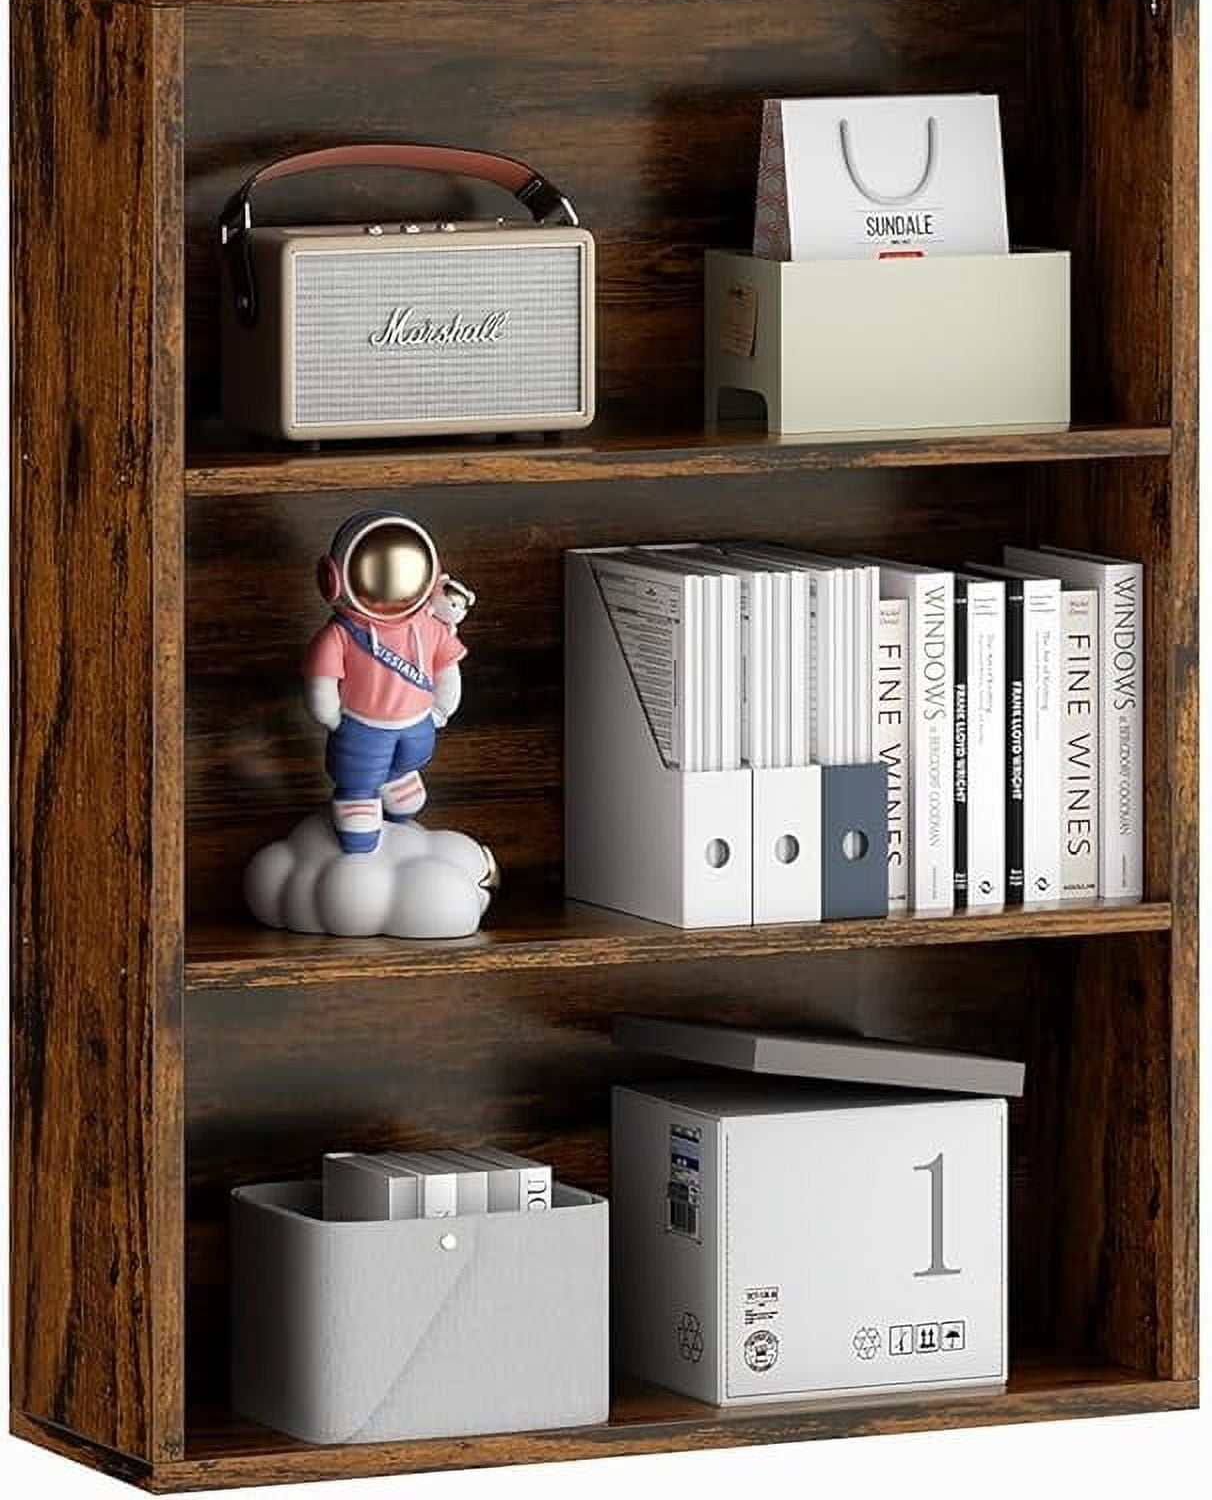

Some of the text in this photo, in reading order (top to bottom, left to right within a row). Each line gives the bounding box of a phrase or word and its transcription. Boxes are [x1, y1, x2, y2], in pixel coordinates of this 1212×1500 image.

[866, 214, 934, 237] SUNDALE
[370, 306, 512, 349] Marshall
[879, 645, 901, 726] FINE
[924, 586, 946, 721] WINDOWS
[1067, 634, 1091, 716] FINE
[1112, 576, 1136, 711] WINDOWS
[1067, 733, 1091, 857] WINES
[912, 1151, 963, 1278] 1
